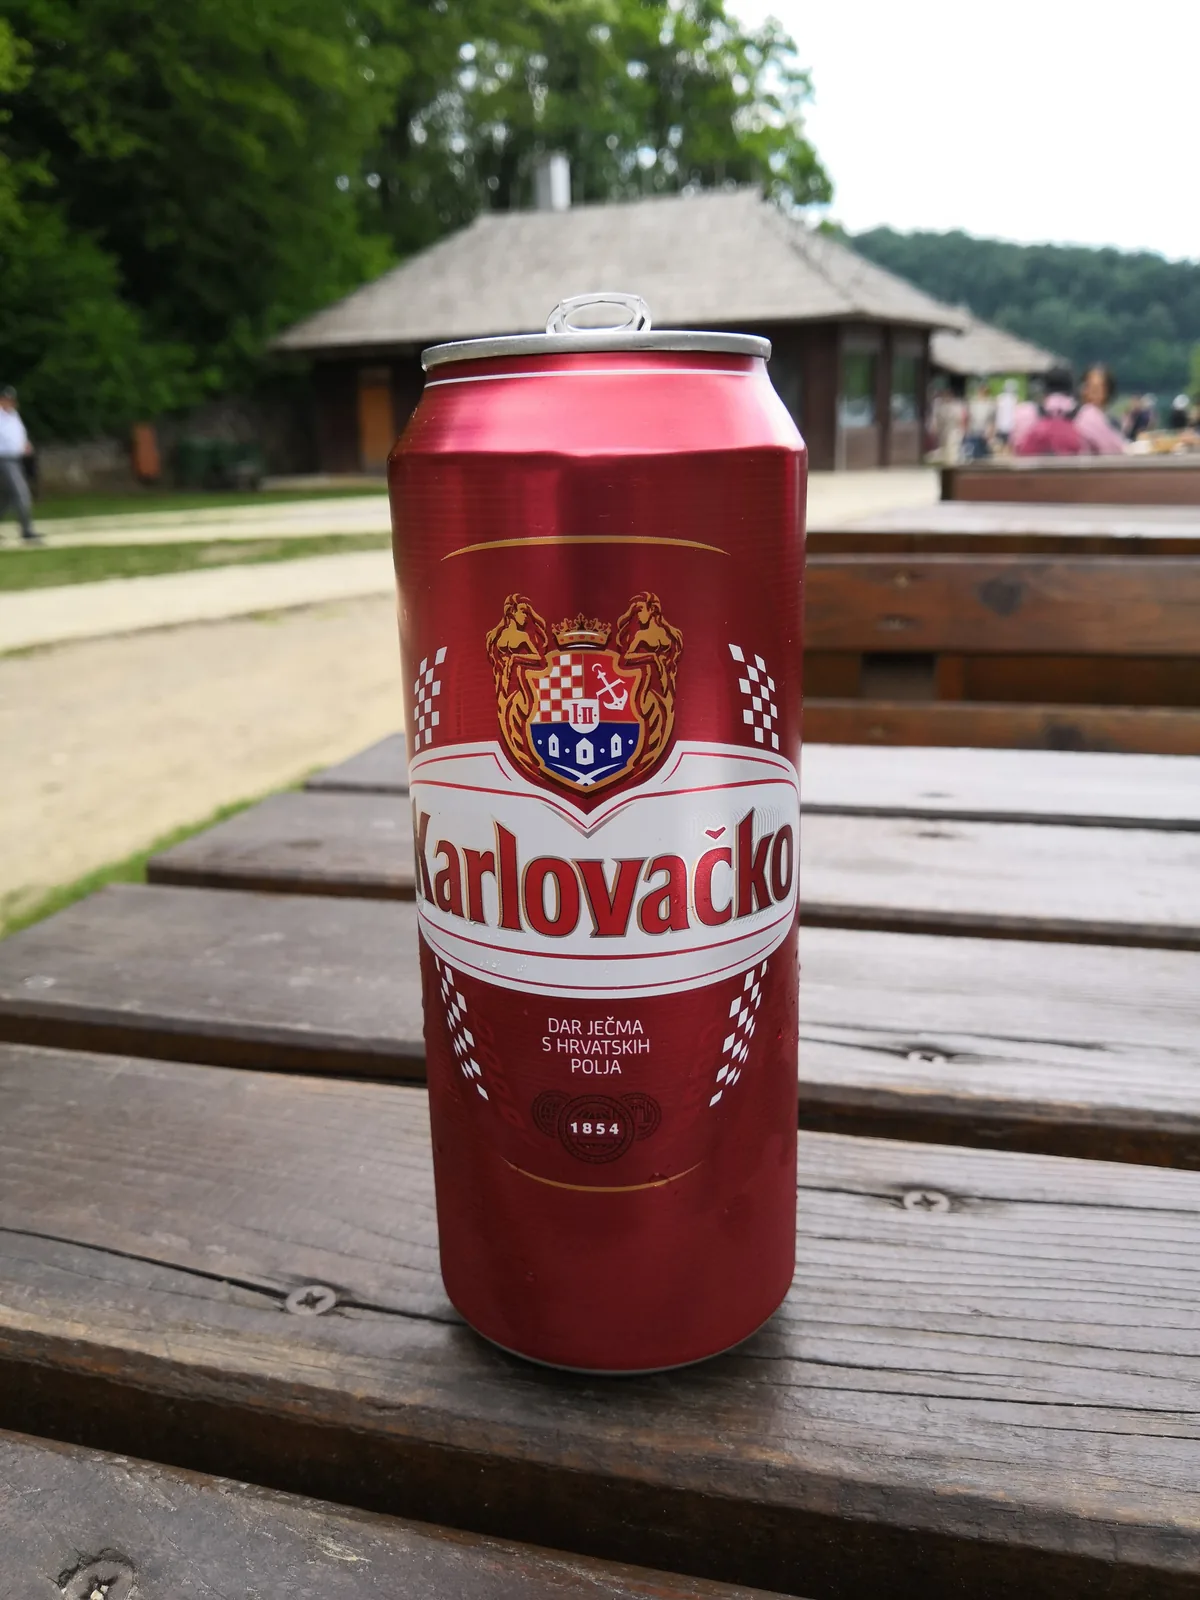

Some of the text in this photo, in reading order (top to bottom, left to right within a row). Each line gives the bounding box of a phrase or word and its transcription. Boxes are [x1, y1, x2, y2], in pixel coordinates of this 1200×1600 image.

[411, 797, 794, 939] Karlovačko
[548, 1016, 644, 1036] DAR JEČMA
[542, 1036, 650, 1055] S HRVATSKIH
[571, 1058, 622, 1075] POLJA
[570, 1122, 619, 1135] 1854
